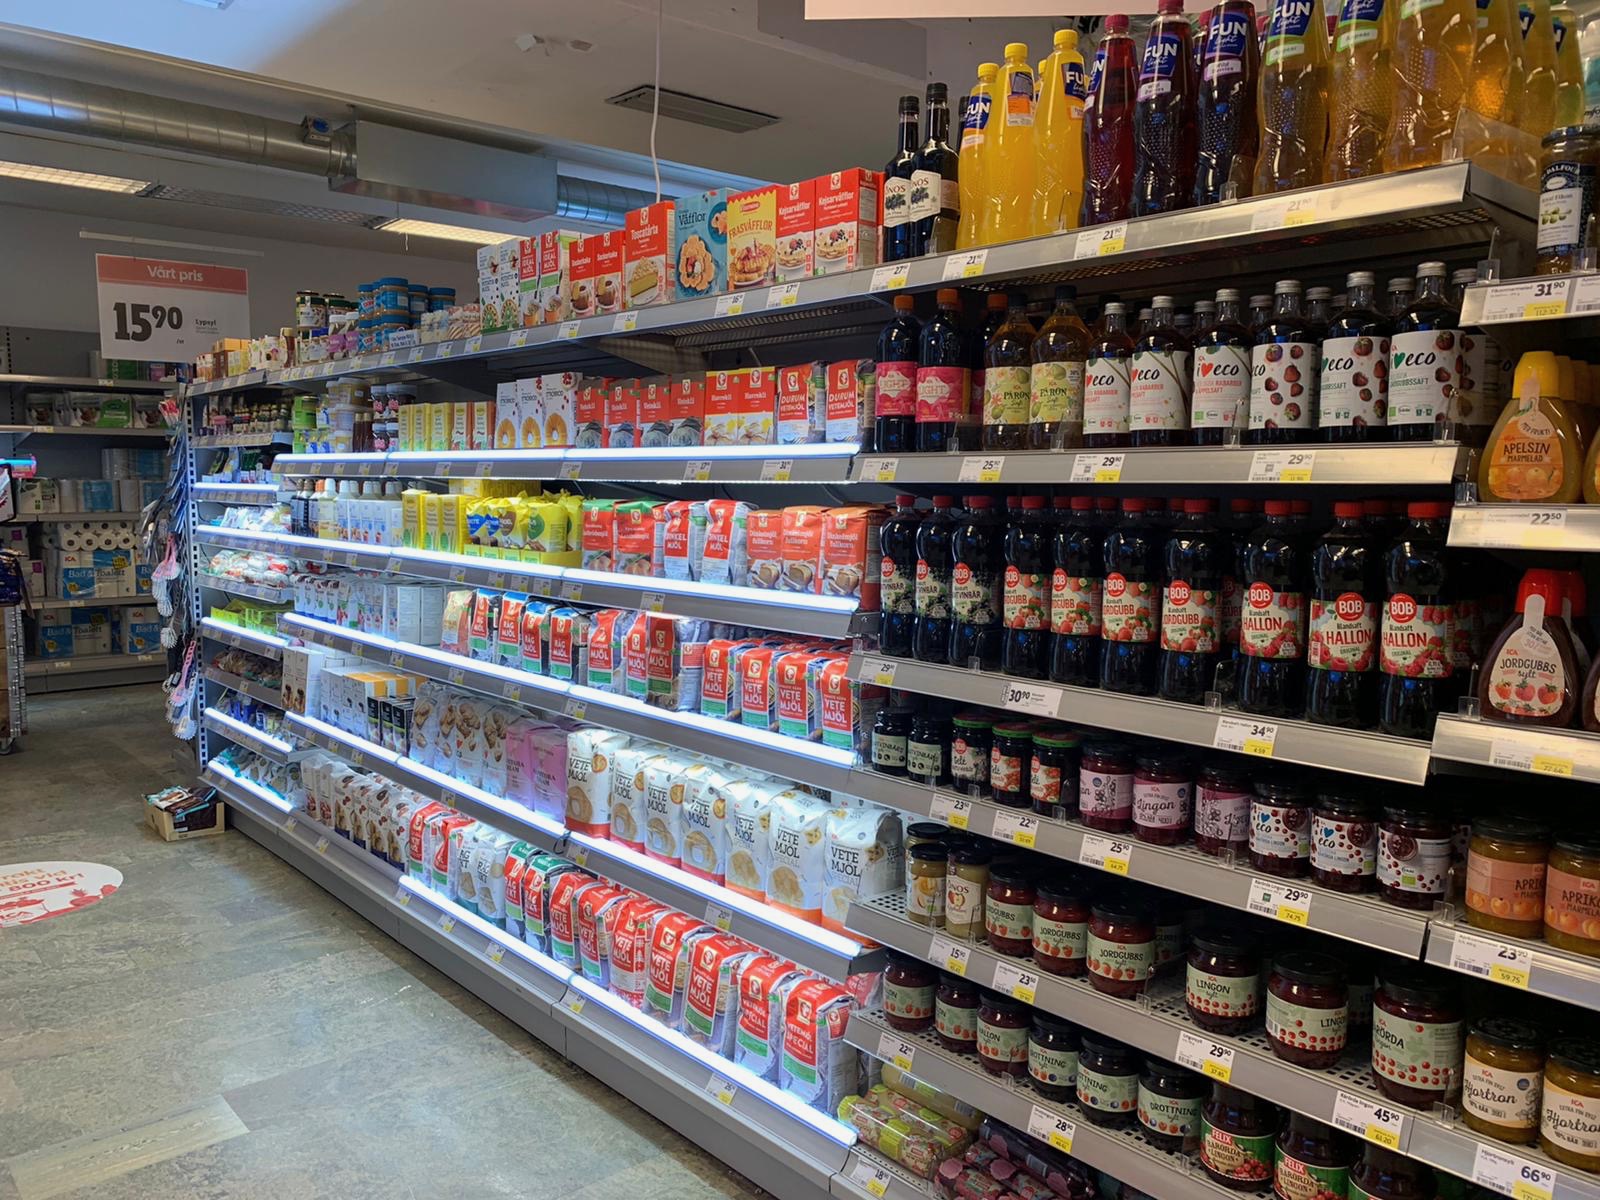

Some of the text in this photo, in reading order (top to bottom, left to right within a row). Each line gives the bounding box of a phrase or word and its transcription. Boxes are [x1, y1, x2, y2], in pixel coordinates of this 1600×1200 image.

[1272, 1, 1310, 23] FUN
[1210, 22, 1247, 40] FUN
[1144, 43, 1177, 62] FUN
[1065, 71, 1084, 84] FU
[966, 102, 990, 119] FUN
[147, 264, 204, 282] Vårt pris
[1328, 357, 1355, 371] eco
[1404, 351, 1437, 366] eco
[1137, 368, 1161, 381] eco
[1212, 363, 1240, 377] eco
[1092, 374, 1115, 387] eco
[828, 391, 855, 403] DURUM
[1503, 442, 1551, 456] APELSIN
[1507, 455, 1543, 463] MARMELAD
[1107, 579, 1124, 590] BOB
[1169, 588, 1189, 600] BOB
[1250, 589, 1271, 601] BOB
[1103, 604, 1135, 616] ORDGUBB
[1338, 600, 1363, 614] BOB
[1391, 602, 1414, 615] BOB
[1243, 616, 1282, 632] HALLON
[1326, 629, 1371, 646] HALLON
[1383, 632, 1427, 648] HALLON
[590, 648, 609, 661] MJÖL
[1505, 648, 1520, 657] ICA
[1500, 657, 1557, 675] JORDGUBBS
[706, 671, 723, 683] VETE
[704, 682, 724, 694] MJÖL
[744, 681, 763, 694] VETE
[744, 692, 764, 705] MJÖL
[779, 689, 801, 701] VETE
[779, 700, 803, 713] MJÖL
[824, 698, 846, 712] VETE
[824, 710, 848, 724] MJÖL
[1250, 724, 1274, 738] 3490
[569, 757, 592, 772] VETE
[615, 771, 632, 788] VETE
[647, 786, 668, 801] VETE
[647, 799, 669, 814] MJÖL
[690, 799, 710, 815] VETE
[1136, 798, 1176, 816] Lingon
[1255, 822, 1272, 834] eco
[777, 828, 799, 846] VETE
[1318, 837, 1335, 849] eco
[774, 840, 800, 859] MJÖL
[831, 846, 859, 864] VETE
[831, 859, 861, 877] MJÖL
[1582, 880, 1596, 889] ICA
[1284, 888, 1309, 901] 2990
[1562, 889, 1600, 907] APRIKO
[986, 904, 1017, 922] ORDGUBBS
[1567, 903, 1600, 917] MARMELA
[1039, 926, 1082, 941] JORDGUBBS
[1099, 947, 1144, 962] JORDGUBBS
[651, 952, 671, 972] VETE
[691, 972, 713, 993] VETE
[1195, 978, 1231, 995] LINGON
[1320, 1017, 1347, 1029] LINGO
[1375, 1024, 1405, 1050] RÖRDA
[1209, 1044, 1232, 1058] 2990
[1481, 1068, 1494, 1079] ICA
[1463, 1078, 1517, 1105] Hjortron
[1149, 1101, 1198, 1117] DROTTNING
[1570, 1098, 1585, 1109] ICA
[1374, 1107, 1400, 1123] 4590
[1211, 1129, 1233, 1145] FELIX
[1284, 1157, 1305, 1172] FELIX
[1520, 1165, 1551, 1183] 6690
